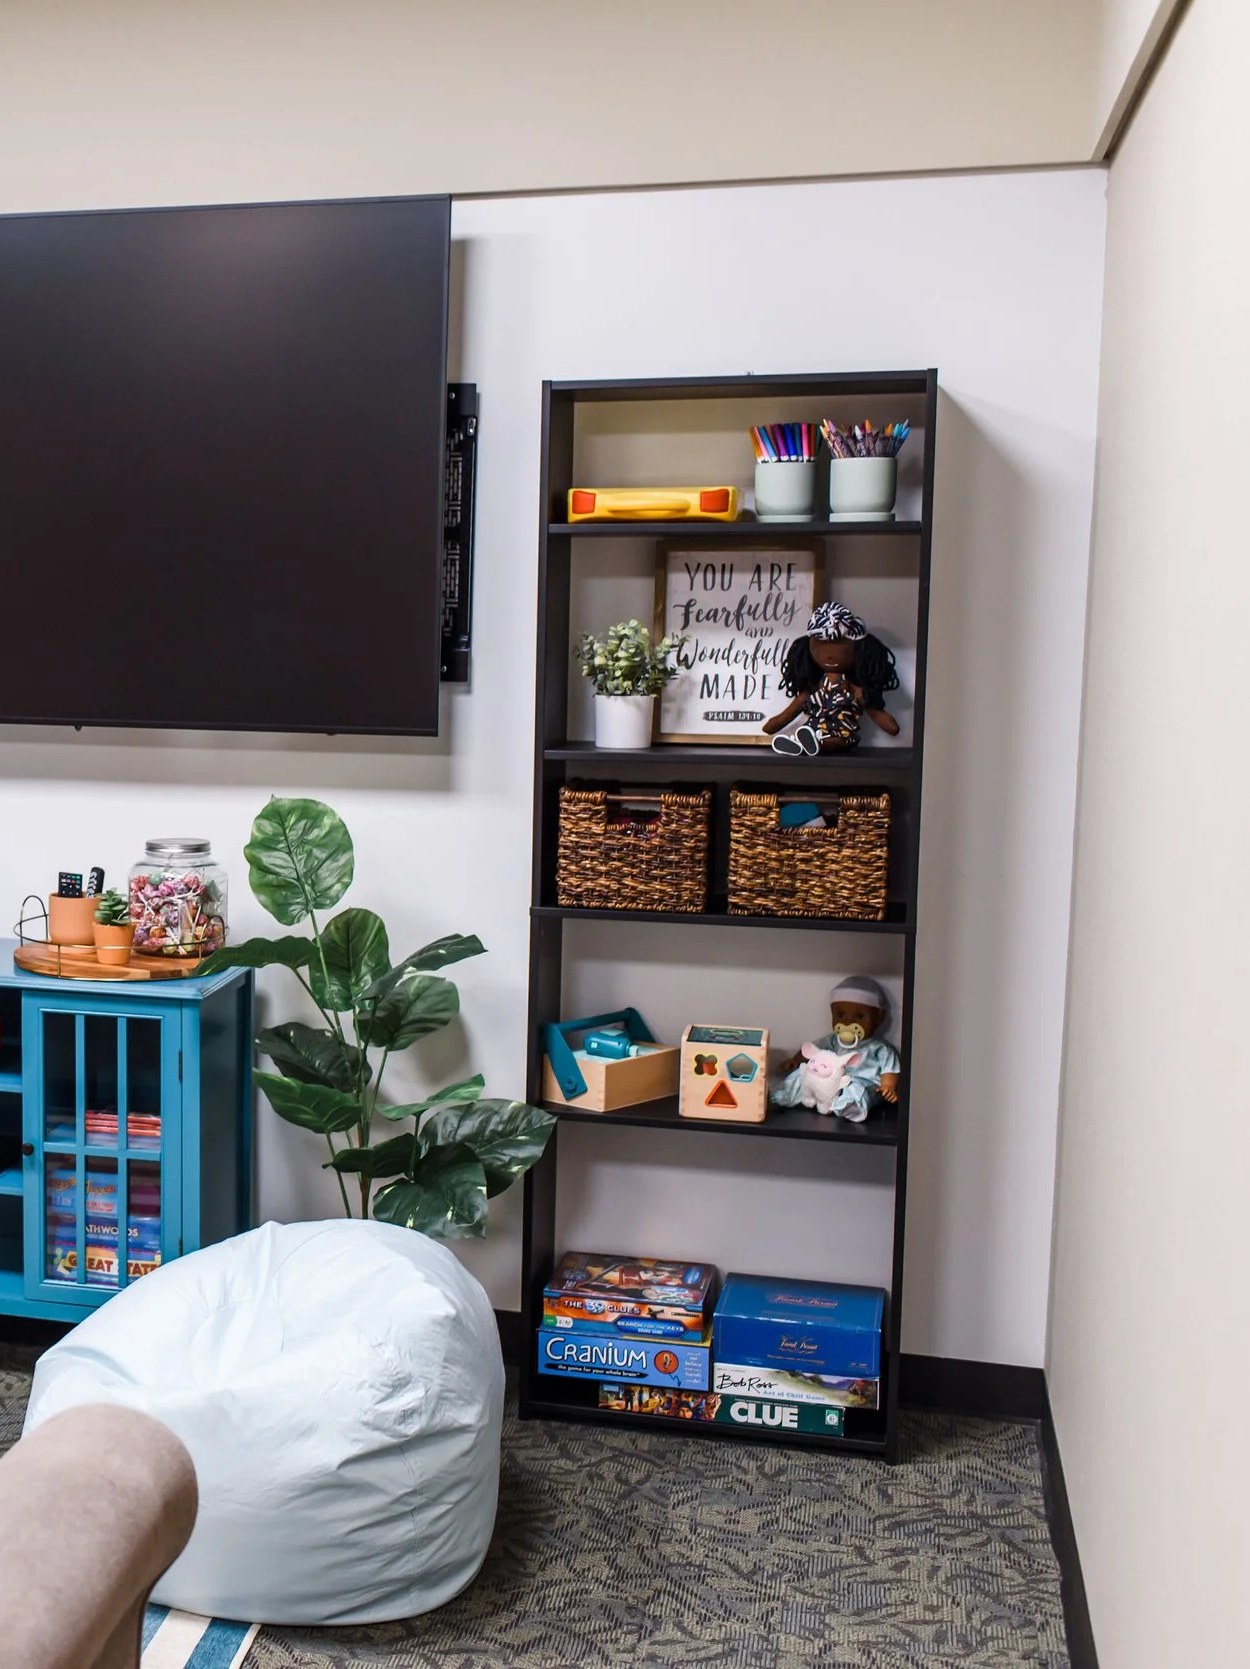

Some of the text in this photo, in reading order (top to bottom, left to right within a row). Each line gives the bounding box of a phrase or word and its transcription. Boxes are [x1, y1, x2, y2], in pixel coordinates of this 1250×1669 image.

[684, 562, 798, 592] YOU ARE
[673, 591, 801, 632] Fearfully
[699, 673, 772, 701] MADE
[563, 1299, 641, 1315] THE 39 CLUES
[616, 1320, 643, 1329] SEARCH
[666, 1325, 685, 1333] KEYS
[567, 1366, 583, 1374] game
[605, 1369, 622, 1377] whole
[716, 1374, 779, 1394] Bob Ross
[730, 1401, 799, 1428] CLUE
